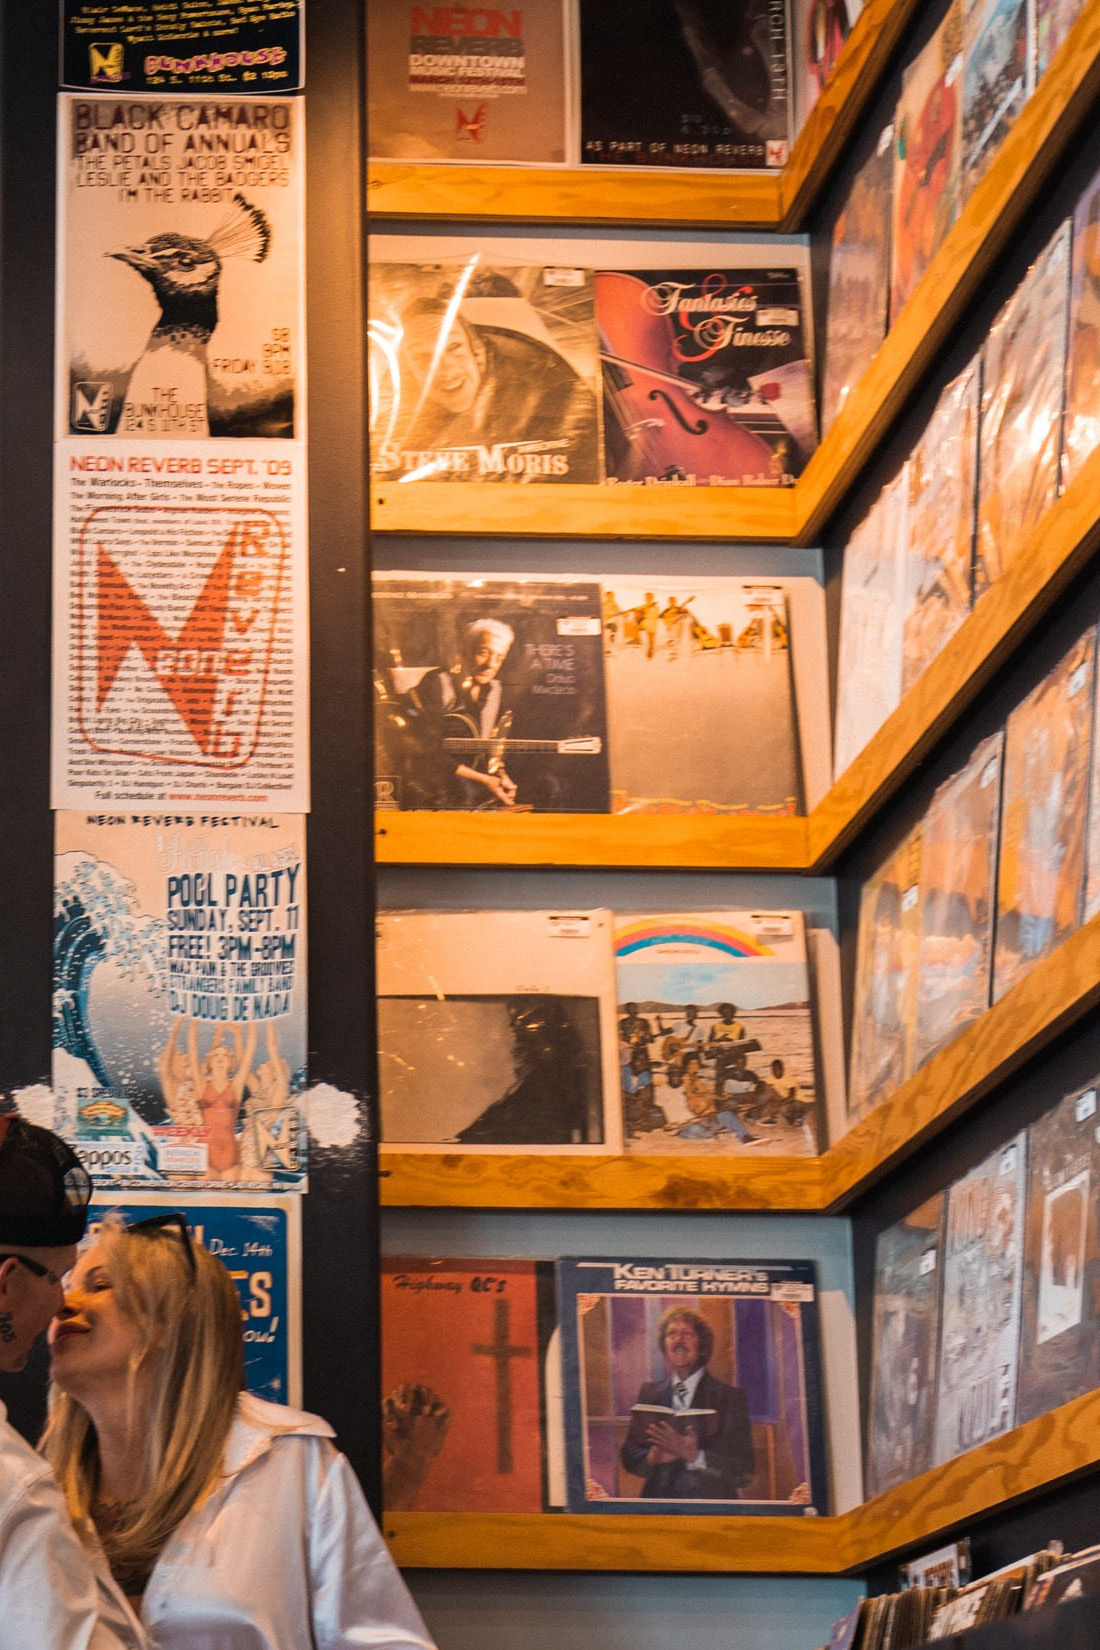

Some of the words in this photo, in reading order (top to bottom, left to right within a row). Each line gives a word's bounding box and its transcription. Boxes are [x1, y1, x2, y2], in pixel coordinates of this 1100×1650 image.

[410, 7, 522, 37] NEON
[410, 35, 525, 56] REVERB
[144, 46, 287, 75] BUNKHOUSE
[409, 54, 525, 68] DOWNTOWN
[75, 104, 165, 130] BLACK
[176, 104, 290, 131] CAMARO
[75, 133, 135, 153] BAND
[145, 133, 173, 153] OF
[183, 133, 291, 153] ANNUALS
[585, 140, 603, 152] AS
[609, 141, 643, 153] PART
[649, 142, 667, 153] OF
[673, 143, 709, 154] NEON
[715, 144, 765, 155] REVERB
[77, 155, 104, 170] THE
[113, 155, 172, 170] PETALS
[177, 155, 227, 170] JACOB
[234, 155, 289, 170] SMIGEL
[75, 172, 132, 187] LESLIE
[139, 172, 172, 187] AND
[178, 172, 209, 187] THE
[214, 172, 290, 188] BADGERS
[145, 188, 174, 203] THE
[181, 188, 233, 203] RABBIT
[640, 281, 758, 316] Fantasies
[693, 315, 791, 350] Finesse
[151, 386, 179, 403] THE
[125, 402, 206, 419] BUNKHOUSE
[68, 455, 125, 473] NEON
[127, 456, 203, 475] REVERB
[206, 458, 258, 475] SEPT.
[477, 445, 569, 475] MORIS
[95, 791, 112, 800] Full
[87, 815, 126, 825] NEON
[131, 815, 195, 827] REVERB
[201, 816, 280, 829] FESTIVAL
[168, 873, 217, 908] POOL
[225, 863, 302, 909] PARTY
[287, 905, 300, 931] 11
[169, 934, 211, 960] FREE!
[218, 933, 297, 960] 3PM-8PM
[614, 1263, 667, 1281] KEN
[393, 1275, 465, 1296] Highway
[614, 1280, 700, 1293] FAVORITE
[702, 1281, 769, 1293] HYMNS
